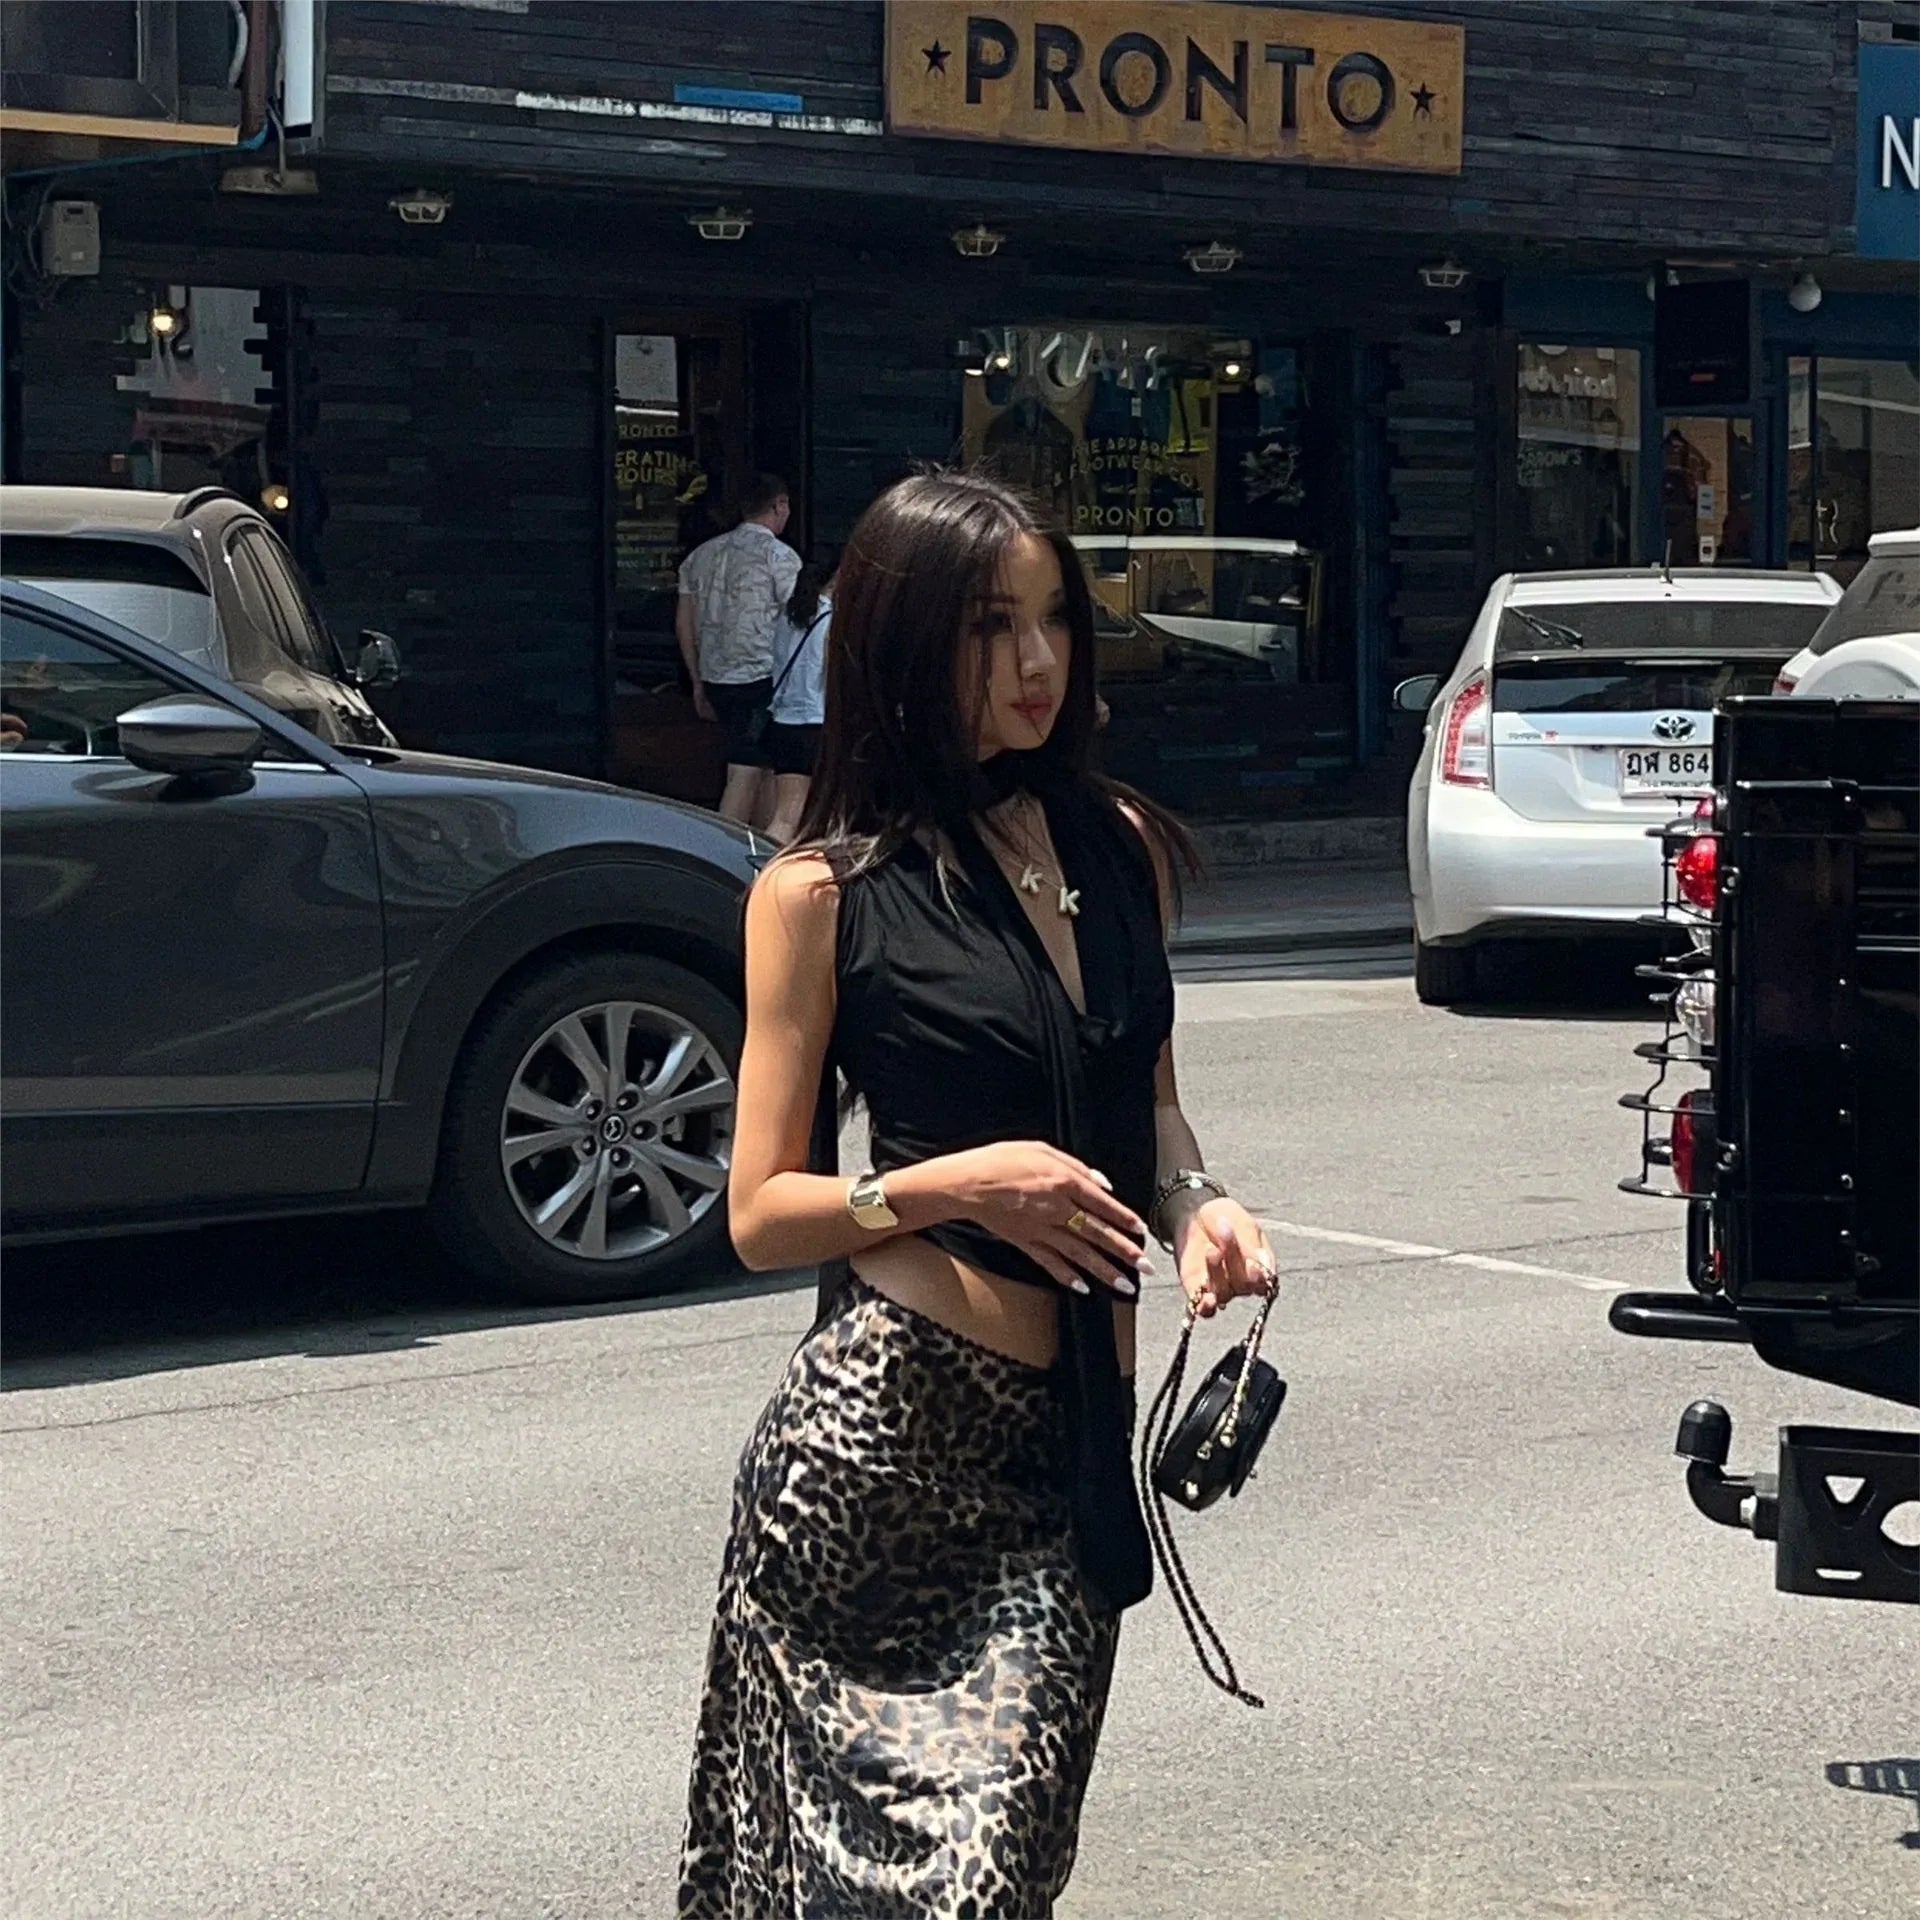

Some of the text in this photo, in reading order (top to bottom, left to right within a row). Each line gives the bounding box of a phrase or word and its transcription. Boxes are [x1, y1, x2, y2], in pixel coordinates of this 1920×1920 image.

[966, 17, 1395, 133] PRONTO
[1077, 505, 1174, 527] PRONTO
[1669, 752, 1709, 773] 864
[1020, 864, 1043, 893] K
[1059, 887, 1081, 916] K
